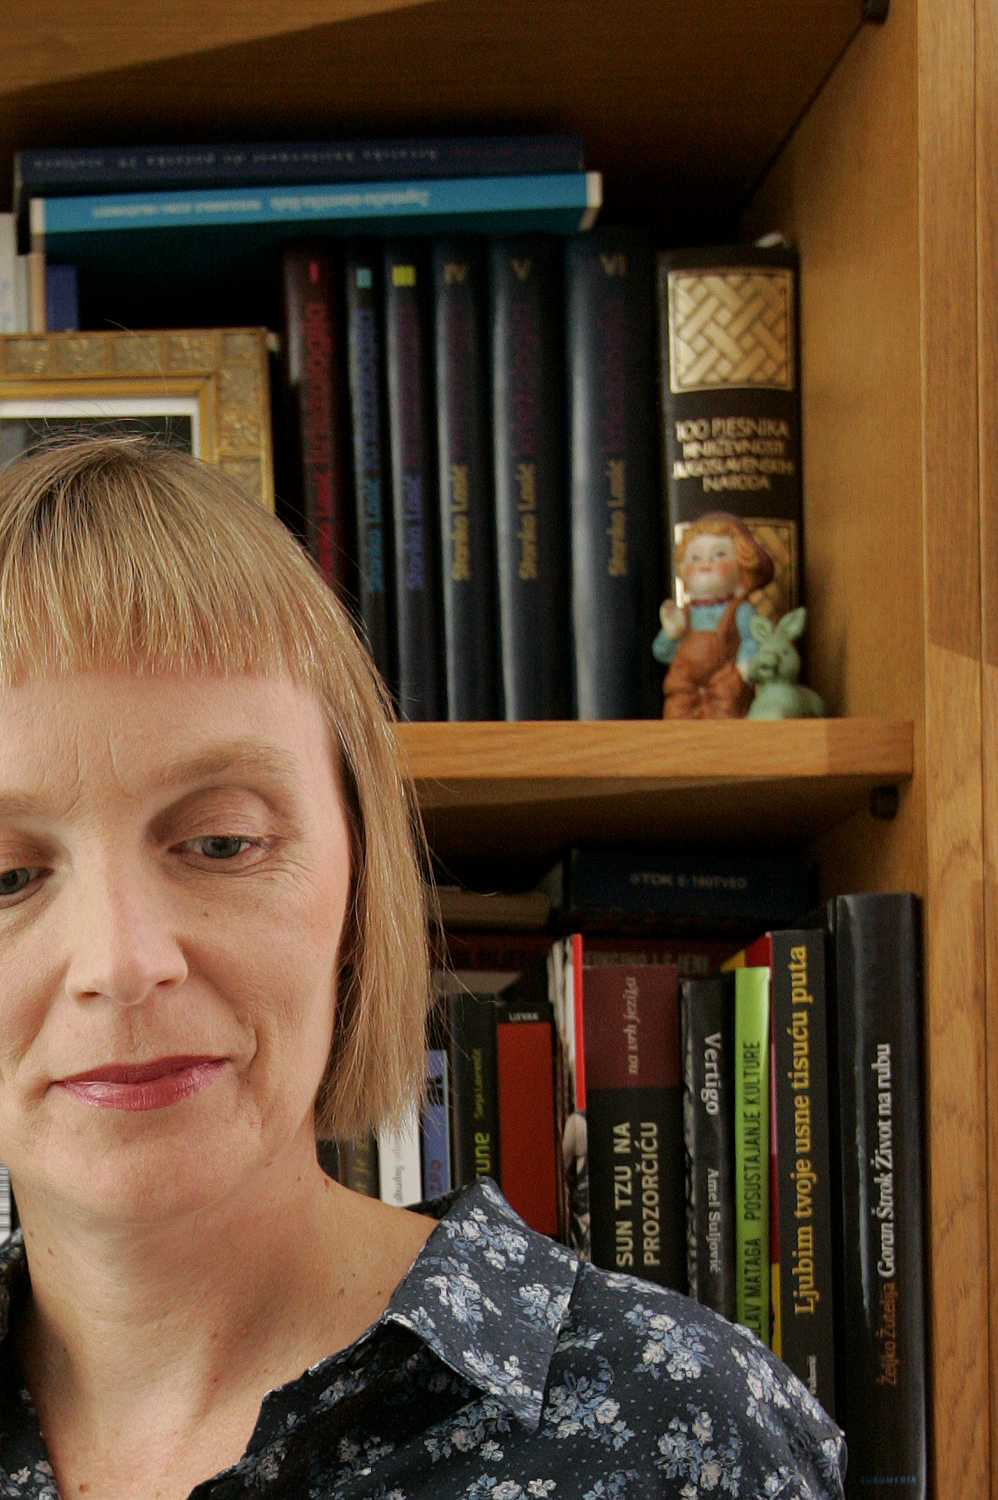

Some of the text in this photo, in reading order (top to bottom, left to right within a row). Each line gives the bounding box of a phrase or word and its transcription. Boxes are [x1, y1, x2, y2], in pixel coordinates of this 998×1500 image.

[675, 419, 710, 442] 100
[620, 975, 641, 1076] na vrh jezika
[702, 1031, 721, 1116] Vertigo
[742, 1041, 762, 1221] POSUSTAJANJE KULTURE
[788, 944, 816, 1315] Ljubim tvoje usne tisuću puta
[869, 1043, 894, 1279] Goran Štrok Život na rubu
[613, 1121, 635, 1268] SUN TZU NA
[634, 1121, 661, 1267] PROZORČIĆU
[705, 1167, 722, 1275] Amel Suljović
[743, 1237, 762, 1299] MATAGA
